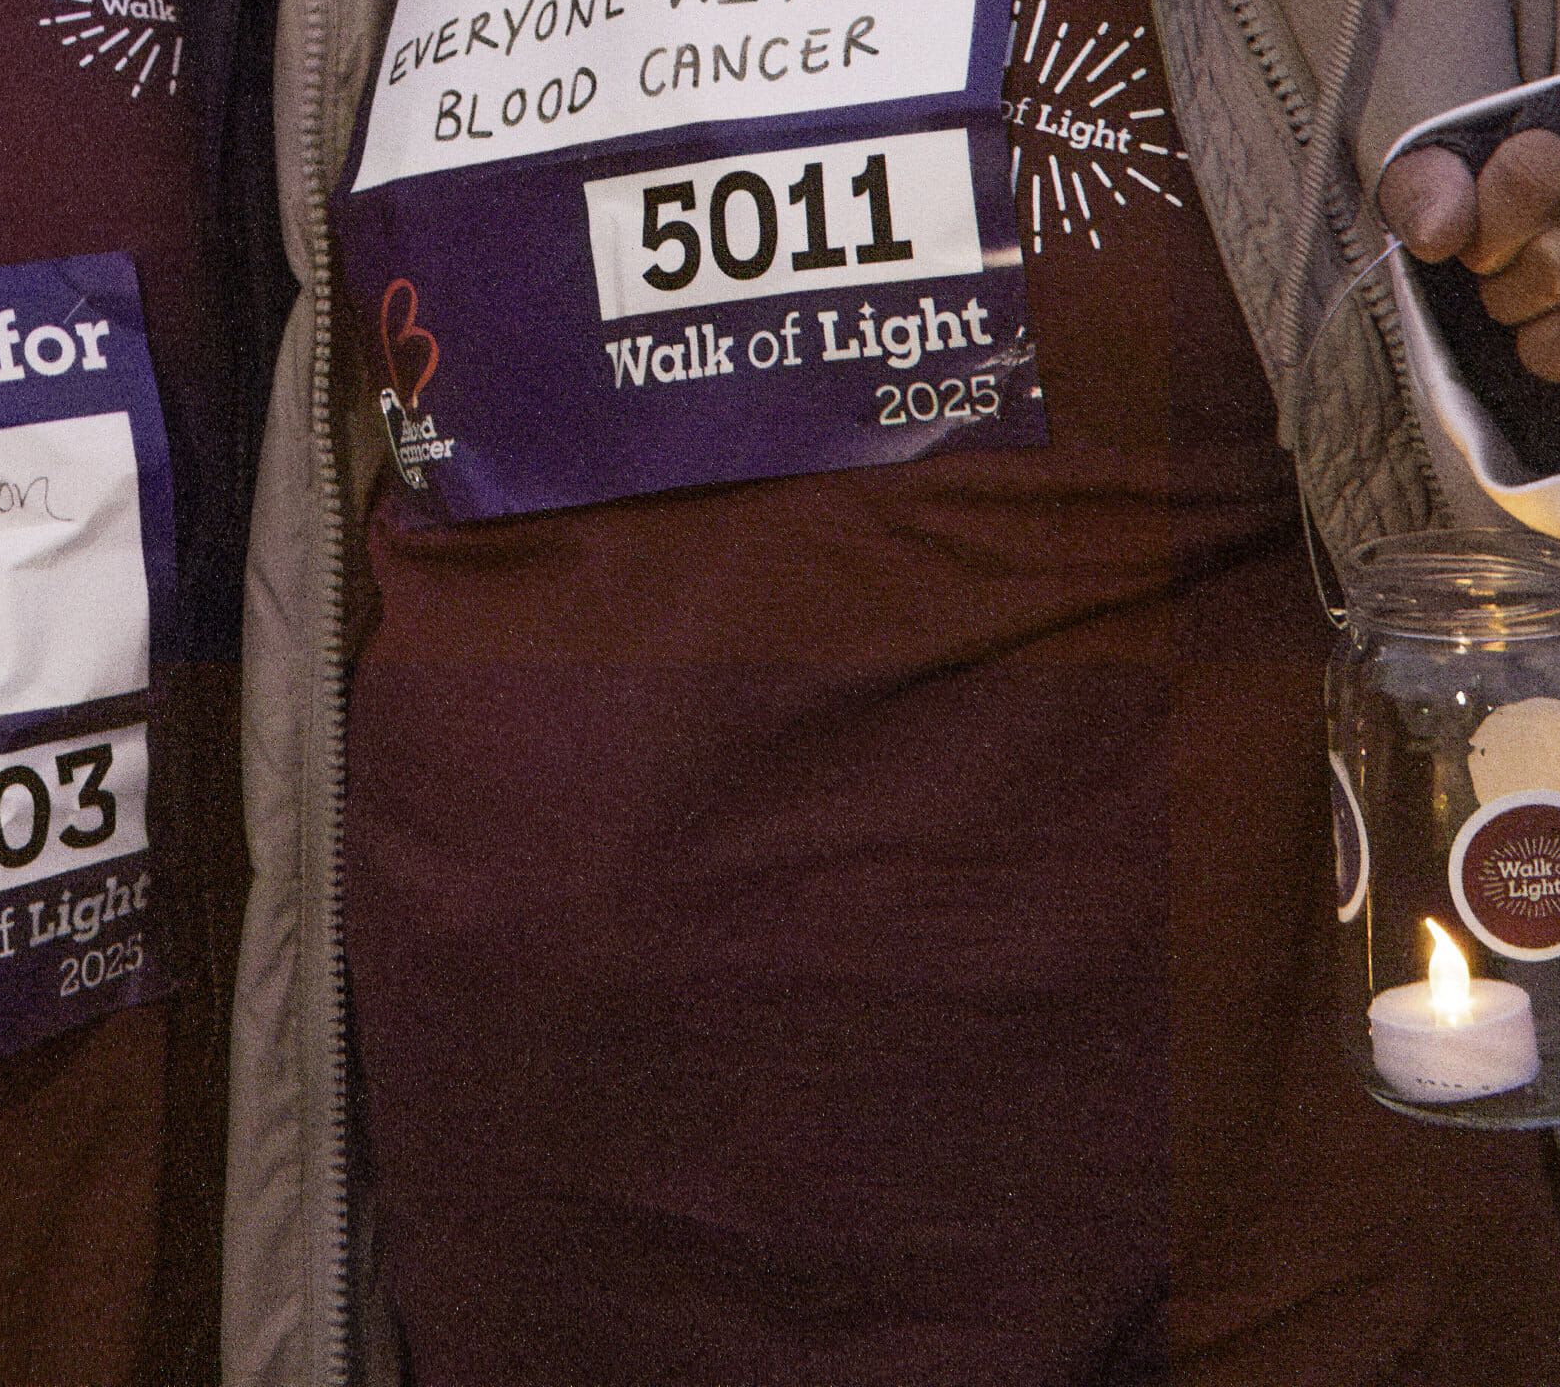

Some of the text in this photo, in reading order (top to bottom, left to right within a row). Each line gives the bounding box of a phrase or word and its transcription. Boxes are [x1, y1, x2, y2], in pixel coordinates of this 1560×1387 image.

[434, 14, 880, 142] BLOOD CANCER
[1035, 103, 1131, 154] Light
[640, 153, 914, 292] 5011
[606, 296, 994, 390] Walk of Light
[875, 374, 1000, 426] 2025
[1497, 857, 1552, 879] Walk
[28, 872, 151, 947] Light
[59, 932, 144, 997] 2025
